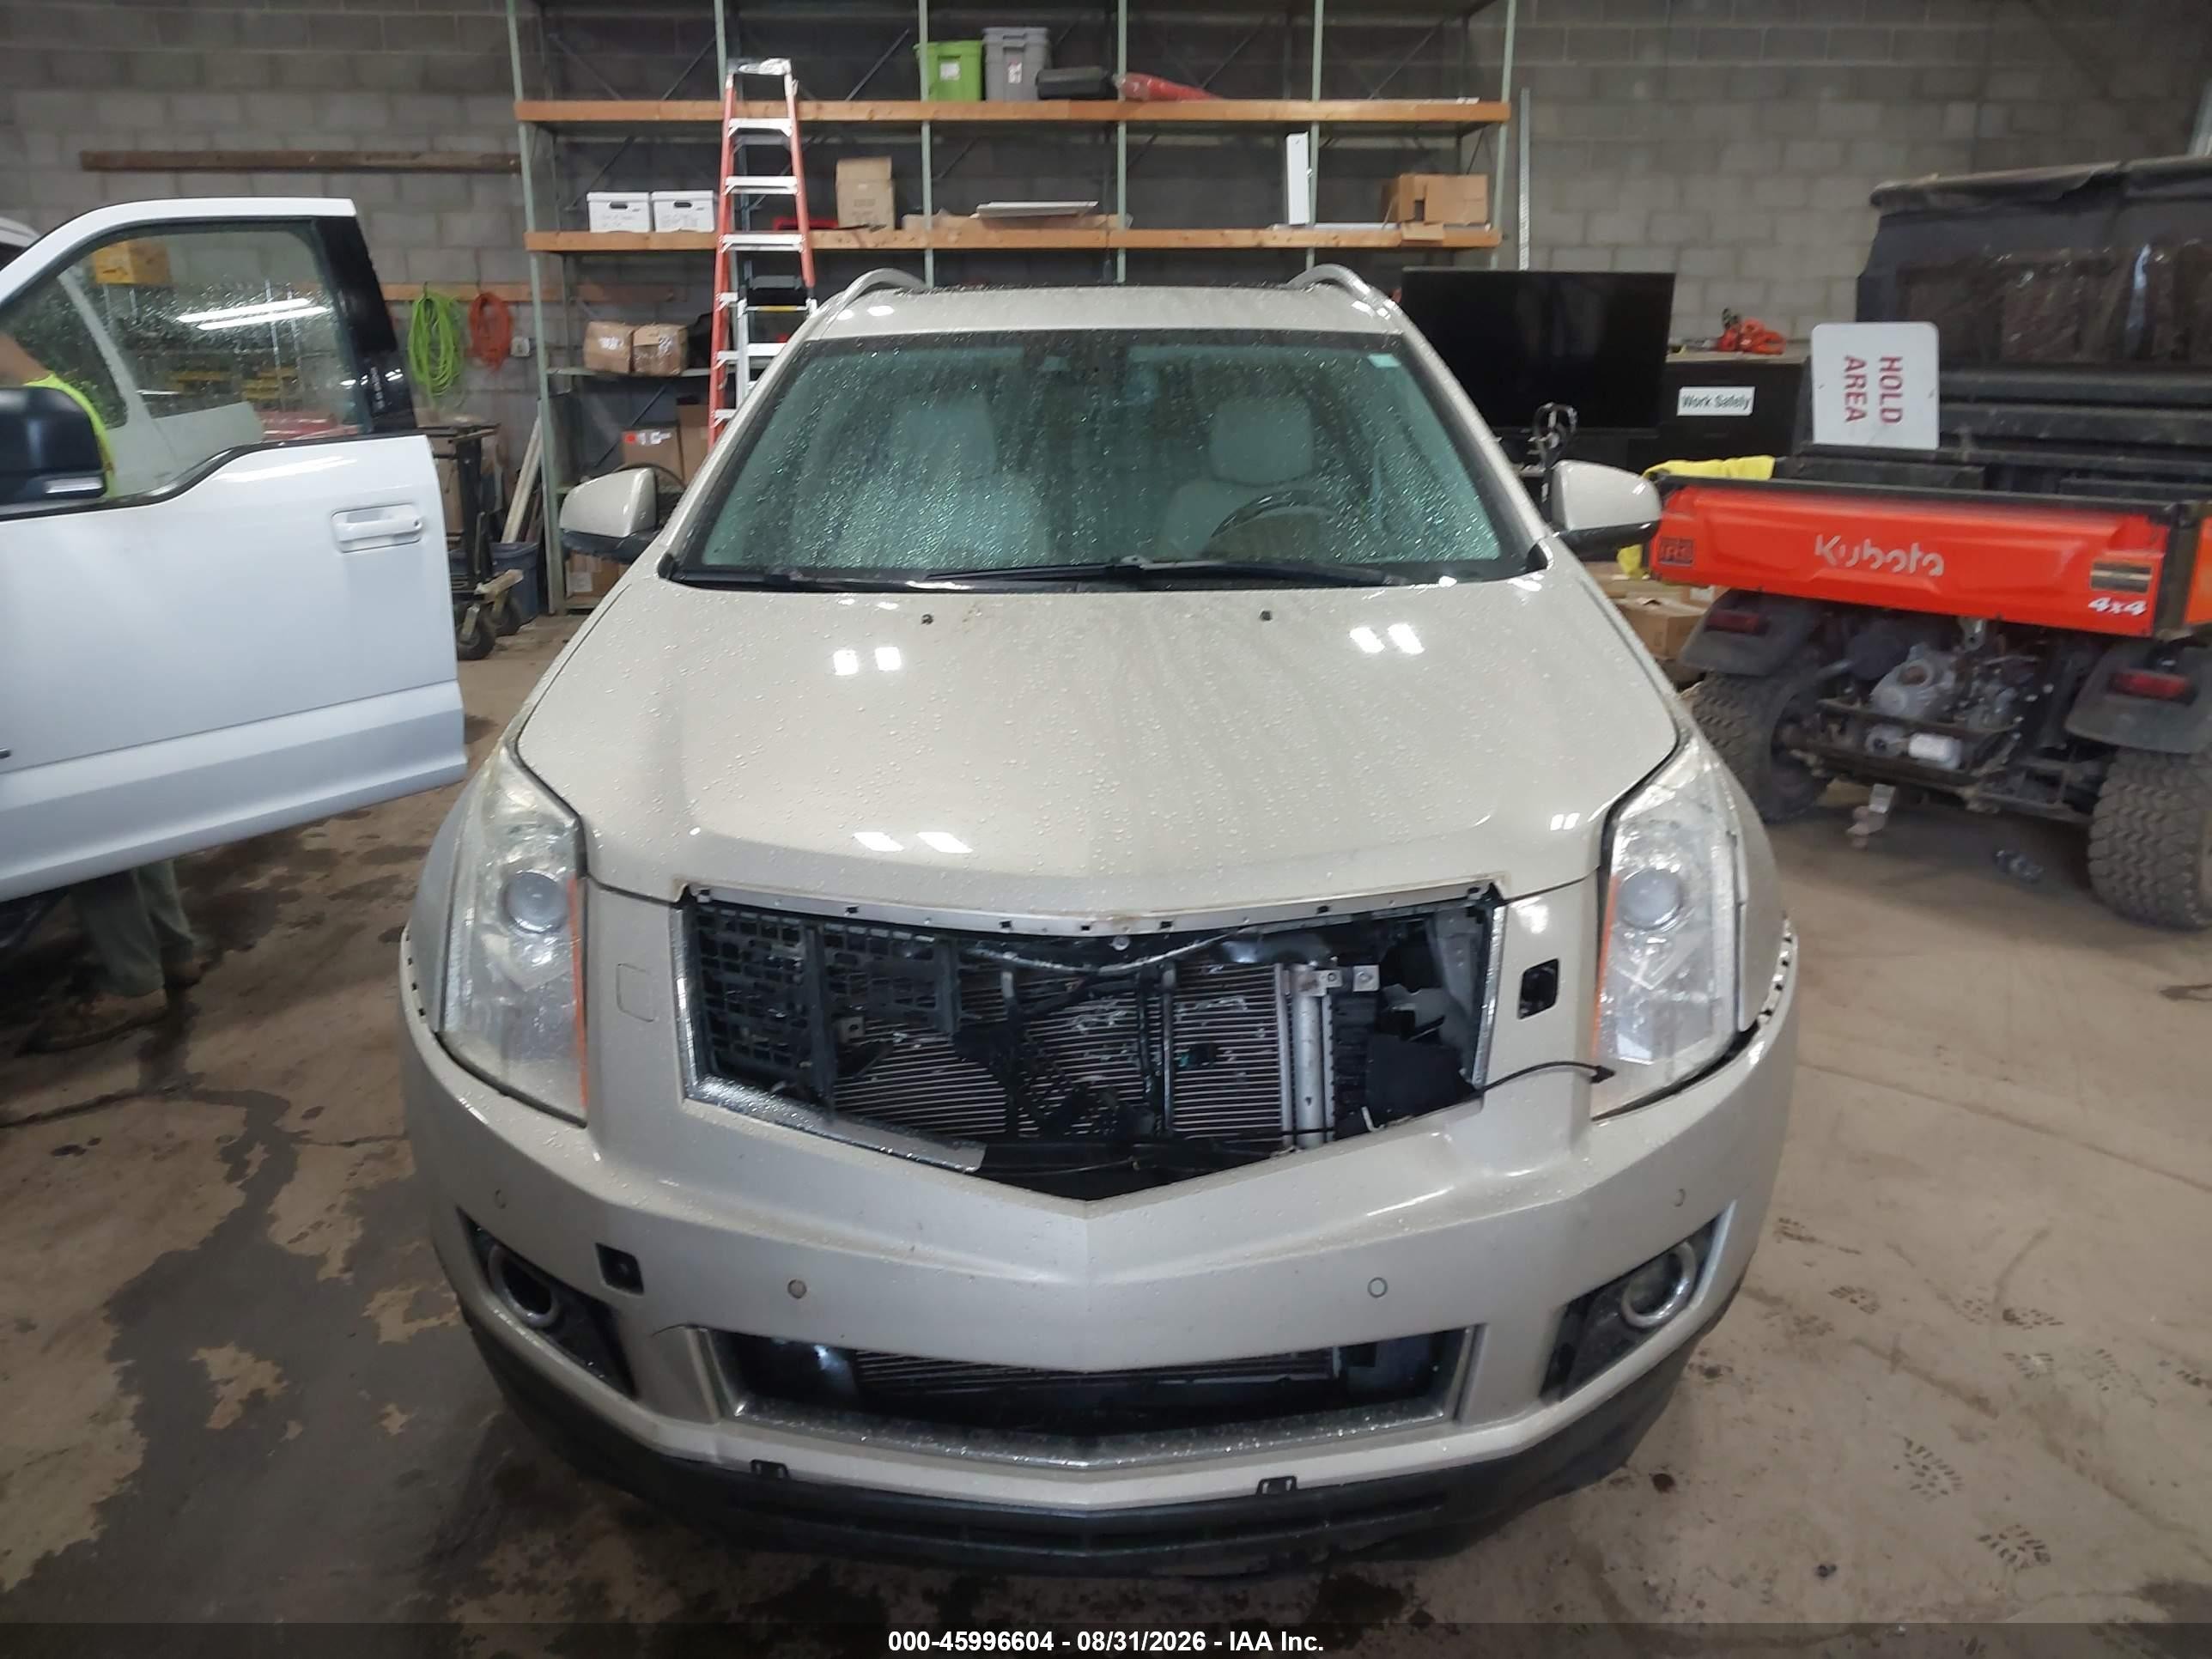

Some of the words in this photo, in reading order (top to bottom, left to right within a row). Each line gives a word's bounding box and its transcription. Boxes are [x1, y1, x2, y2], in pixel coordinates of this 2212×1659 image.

[1681, 395, 1712, 408] Work
[1714, 394, 1751, 410] Safely
[1844, 356, 1868, 422] AREA
[1879, 356, 1903, 423] HOLD
[1814, 533, 1945, 577] Kubota
[2087, 597, 2148, 616] 4x4
